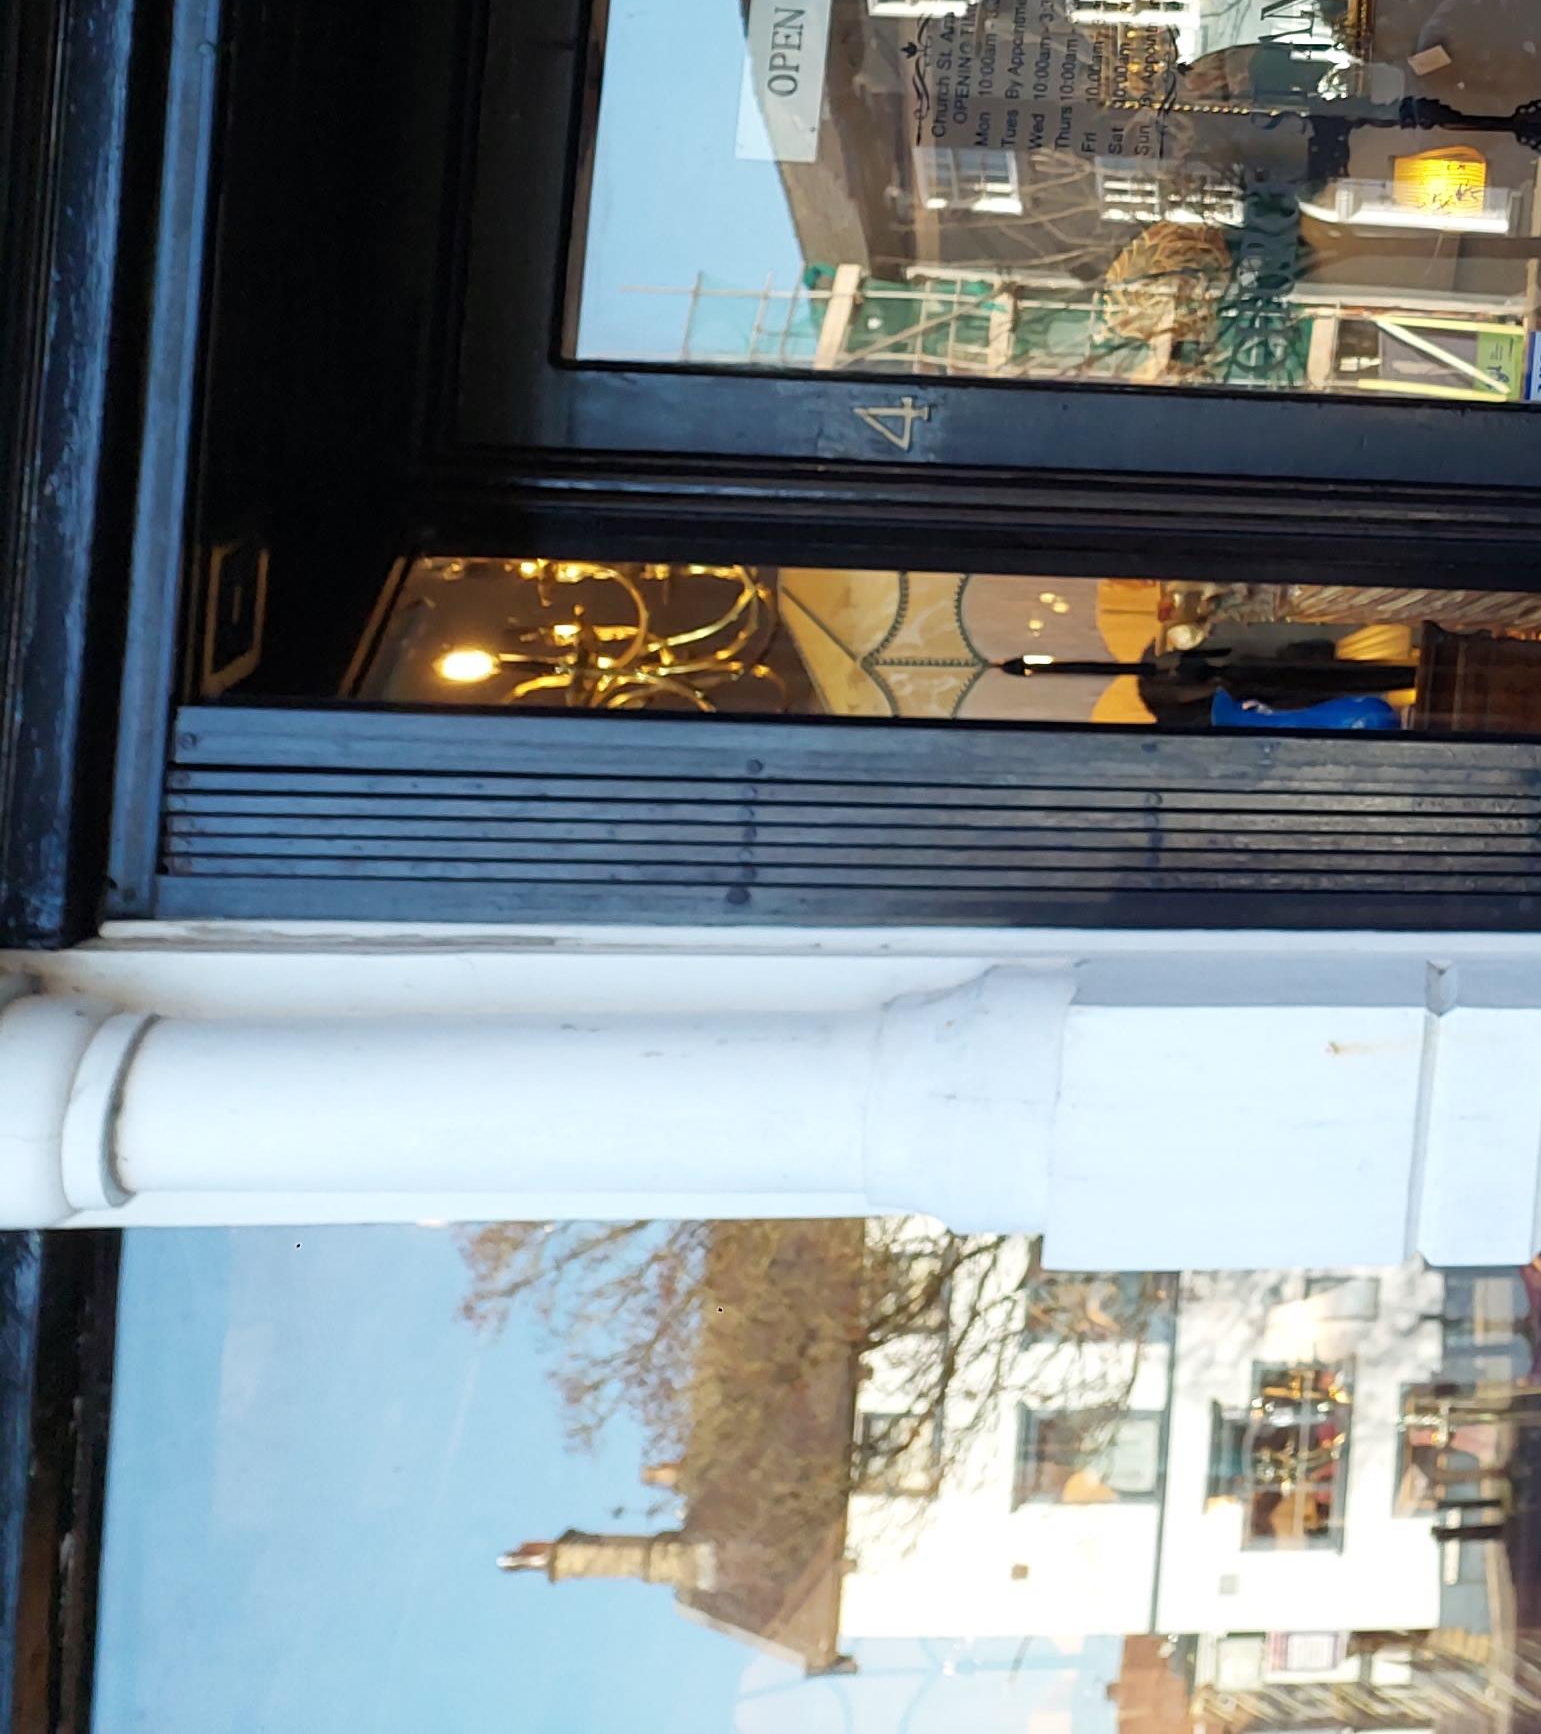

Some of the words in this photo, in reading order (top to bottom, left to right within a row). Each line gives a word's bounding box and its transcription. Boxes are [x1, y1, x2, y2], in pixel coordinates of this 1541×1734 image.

[767, 6, 806, 97] OPEN
[978, 34, 997, 96] 10:00am
[1033, 36, 1053, 100] 10:00am
[1059, 38, 1079, 101] 10:00am
[953, 41, 973, 124] OPENING
[1005, 80, 1023, 99] By
[931, 76, 951, 138] Church
[974, 112, 991, 147] Mon
[1001, 109, 1019, 147] Tues
[1054, 106, 1073, 151] Thurs
[1028, 113, 1046, 150] Wed
[1081, 132, 1097, 153] Fri
[1107, 127, 1125, 155] Sat
[1134, 124, 1151, 156] Sun
[853, 396, 930, 451] 4
